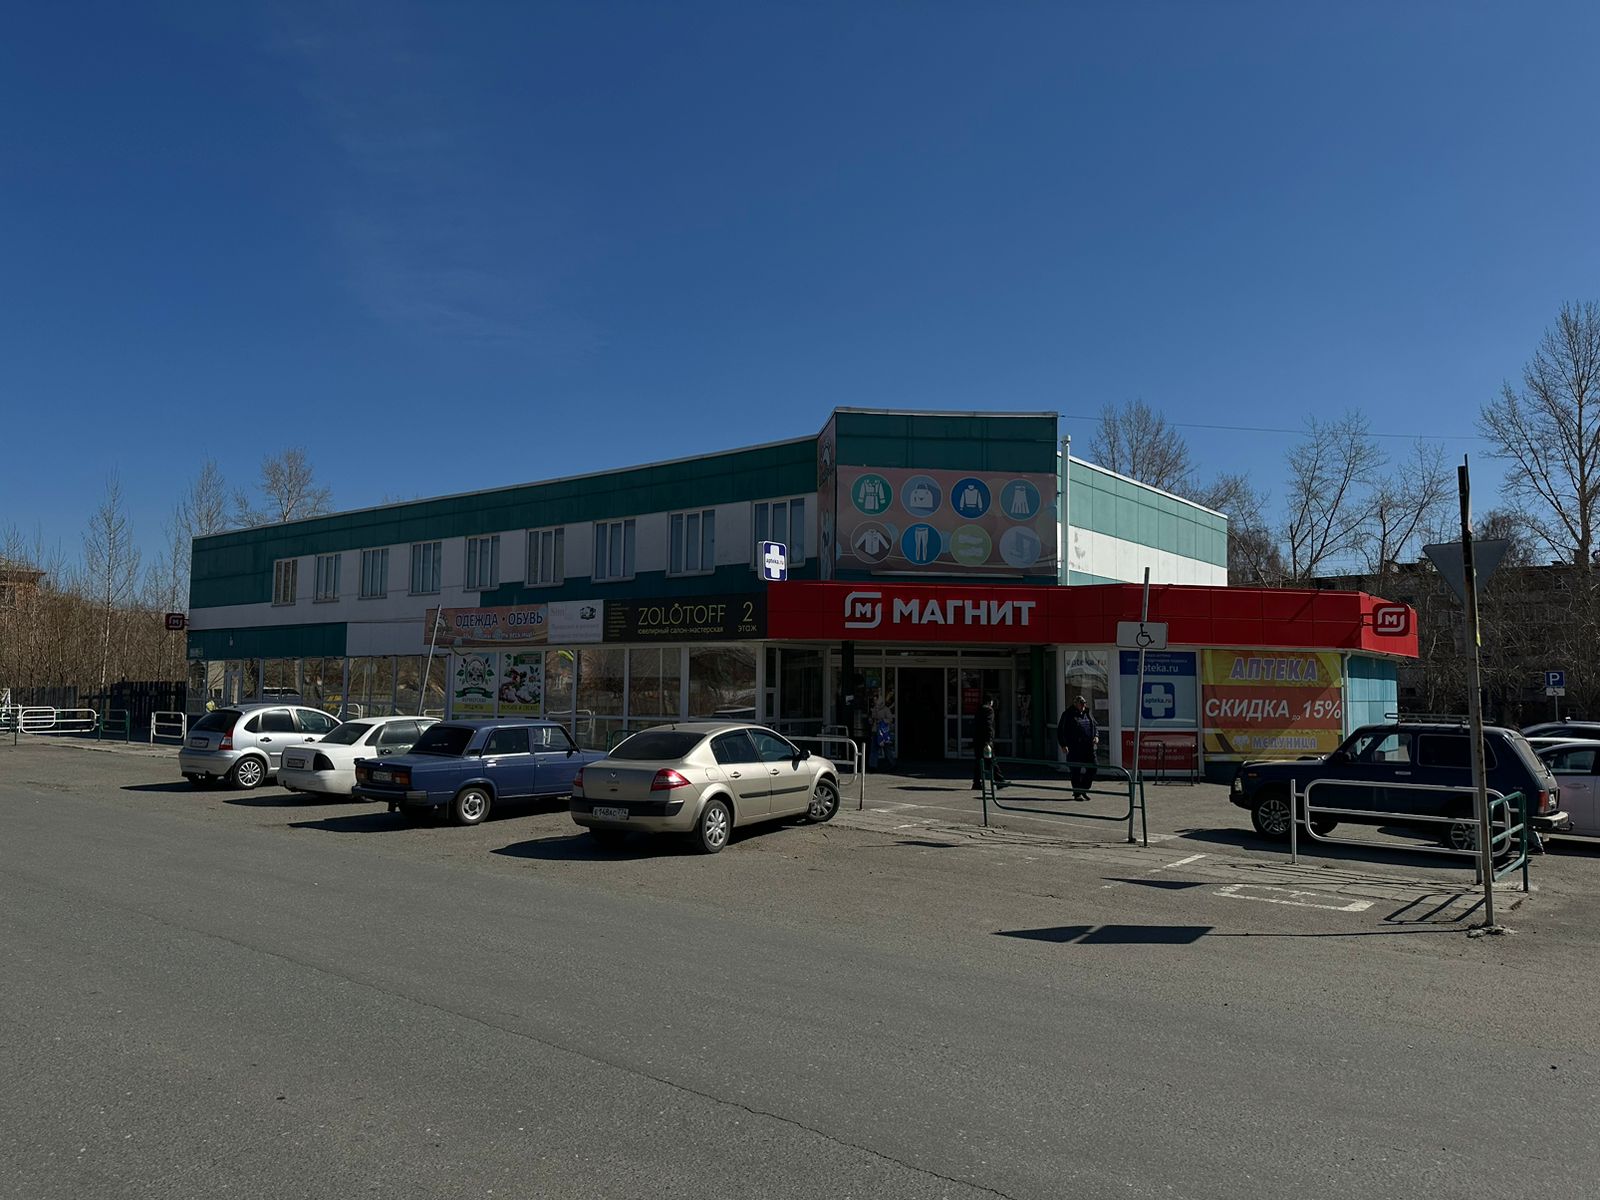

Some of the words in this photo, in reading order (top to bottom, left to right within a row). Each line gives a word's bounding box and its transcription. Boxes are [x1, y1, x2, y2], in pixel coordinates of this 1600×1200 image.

[455, 613, 498, 628] ОДЕЖДА
[508, 611, 543, 626] ОБУВЬ
[743, 601, 754, 622] 2
[893, 597, 1036, 626] МАГНИТ
[638, 626, 669, 636] ювелирный
[670, 626, 724, 635] салон-мастерская
[737, 624, 757, 633] этаж
[1230, 657, 1318, 681] АПТЕКА
[1145, 697, 1171, 705] apteka.ru
[1205, 698, 1289, 722] СКИДКА
[1303, 700, 1341, 719] 15%
[1252, 736, 1317, 749] МЕДУНИЦА
